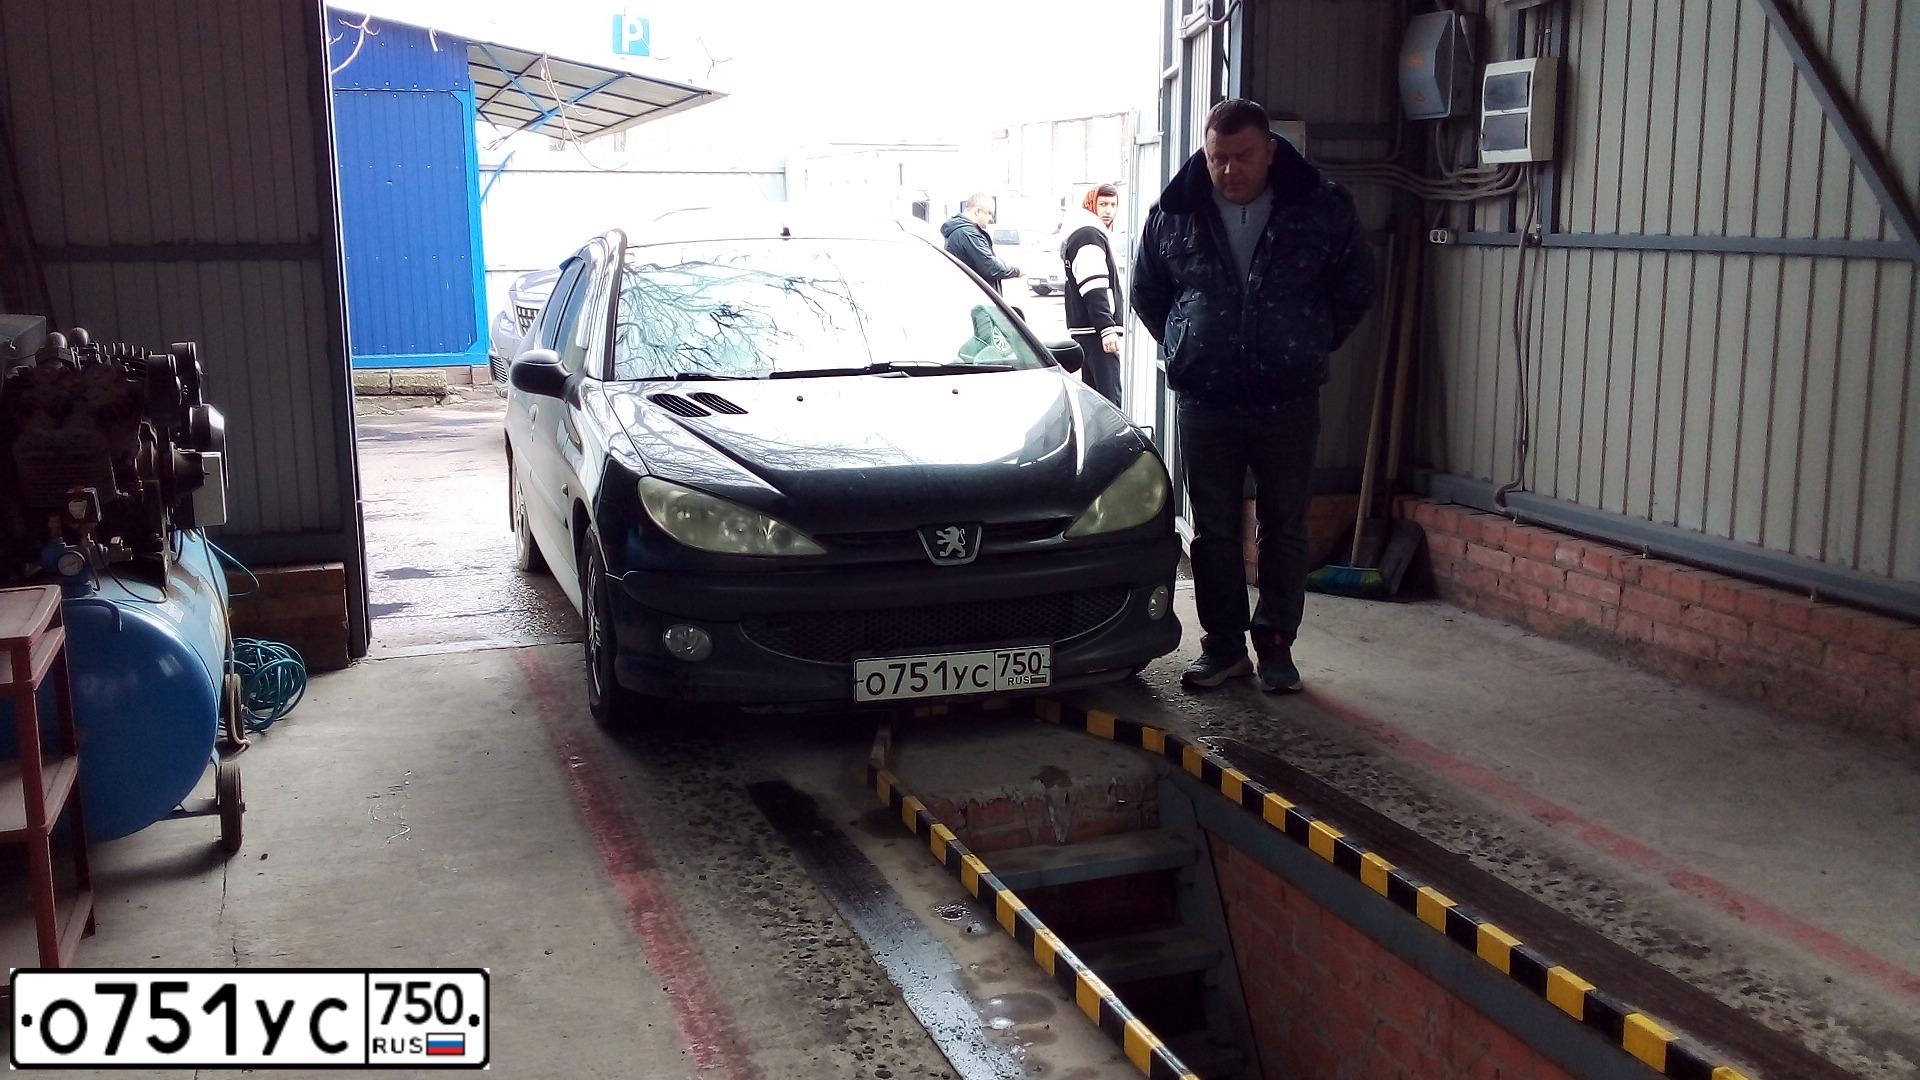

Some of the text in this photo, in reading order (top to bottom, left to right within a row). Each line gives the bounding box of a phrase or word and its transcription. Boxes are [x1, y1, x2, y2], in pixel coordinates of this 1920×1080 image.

[621, 16, 643, 53] P
[997, 652, 1042, 677] 750
[1007, 676, 1030, 686] RUS
